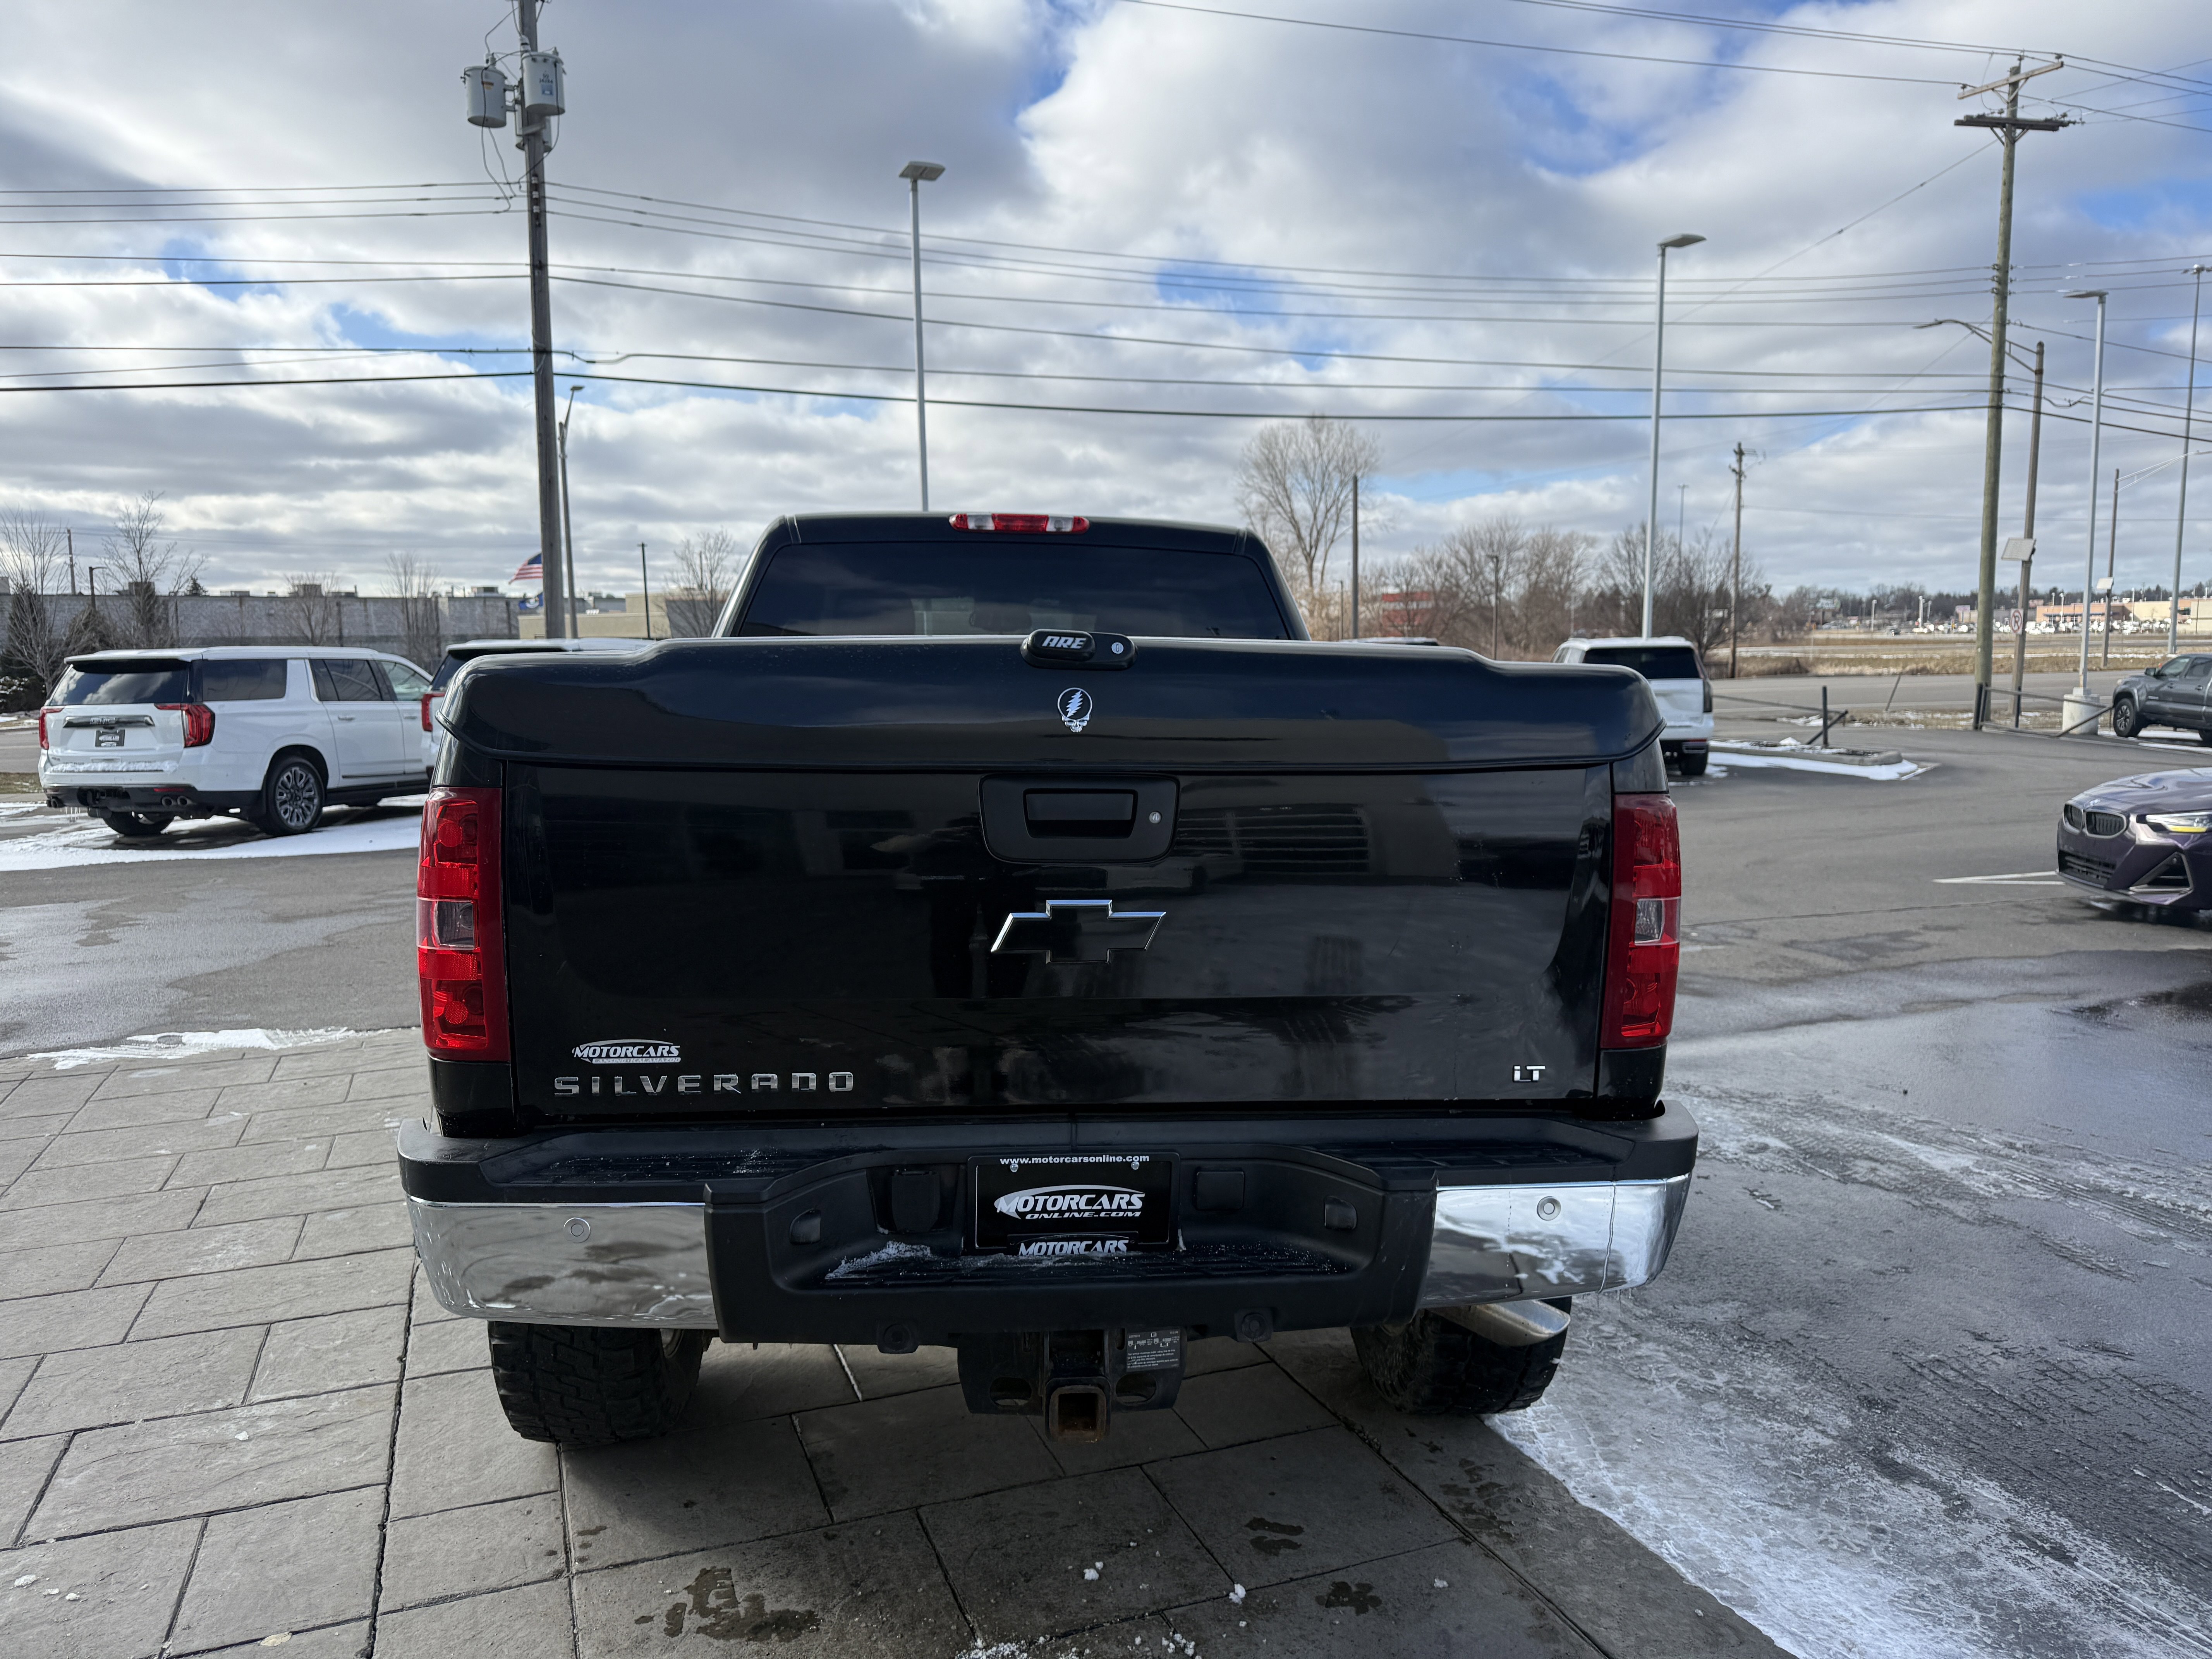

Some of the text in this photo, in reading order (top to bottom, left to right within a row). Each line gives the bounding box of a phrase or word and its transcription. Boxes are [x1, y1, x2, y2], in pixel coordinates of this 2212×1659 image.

[1042, 635, 1087, 649] ARE
[574, 1045, 680, 1058] MOTORCARS
[1514, 1066, 1546, 1082] LT
[554, 1072, 854, 1095] SILVERADO
[1000, 1154, 1150, 1165] www.motorcarsonline.com
[997, 1193, 1146, 1213] MOTORCARS
[1025, 1211, 1142, 1220] ONLINE.COM
[1018, 1240, 1129, 1255] MOTORCARS
